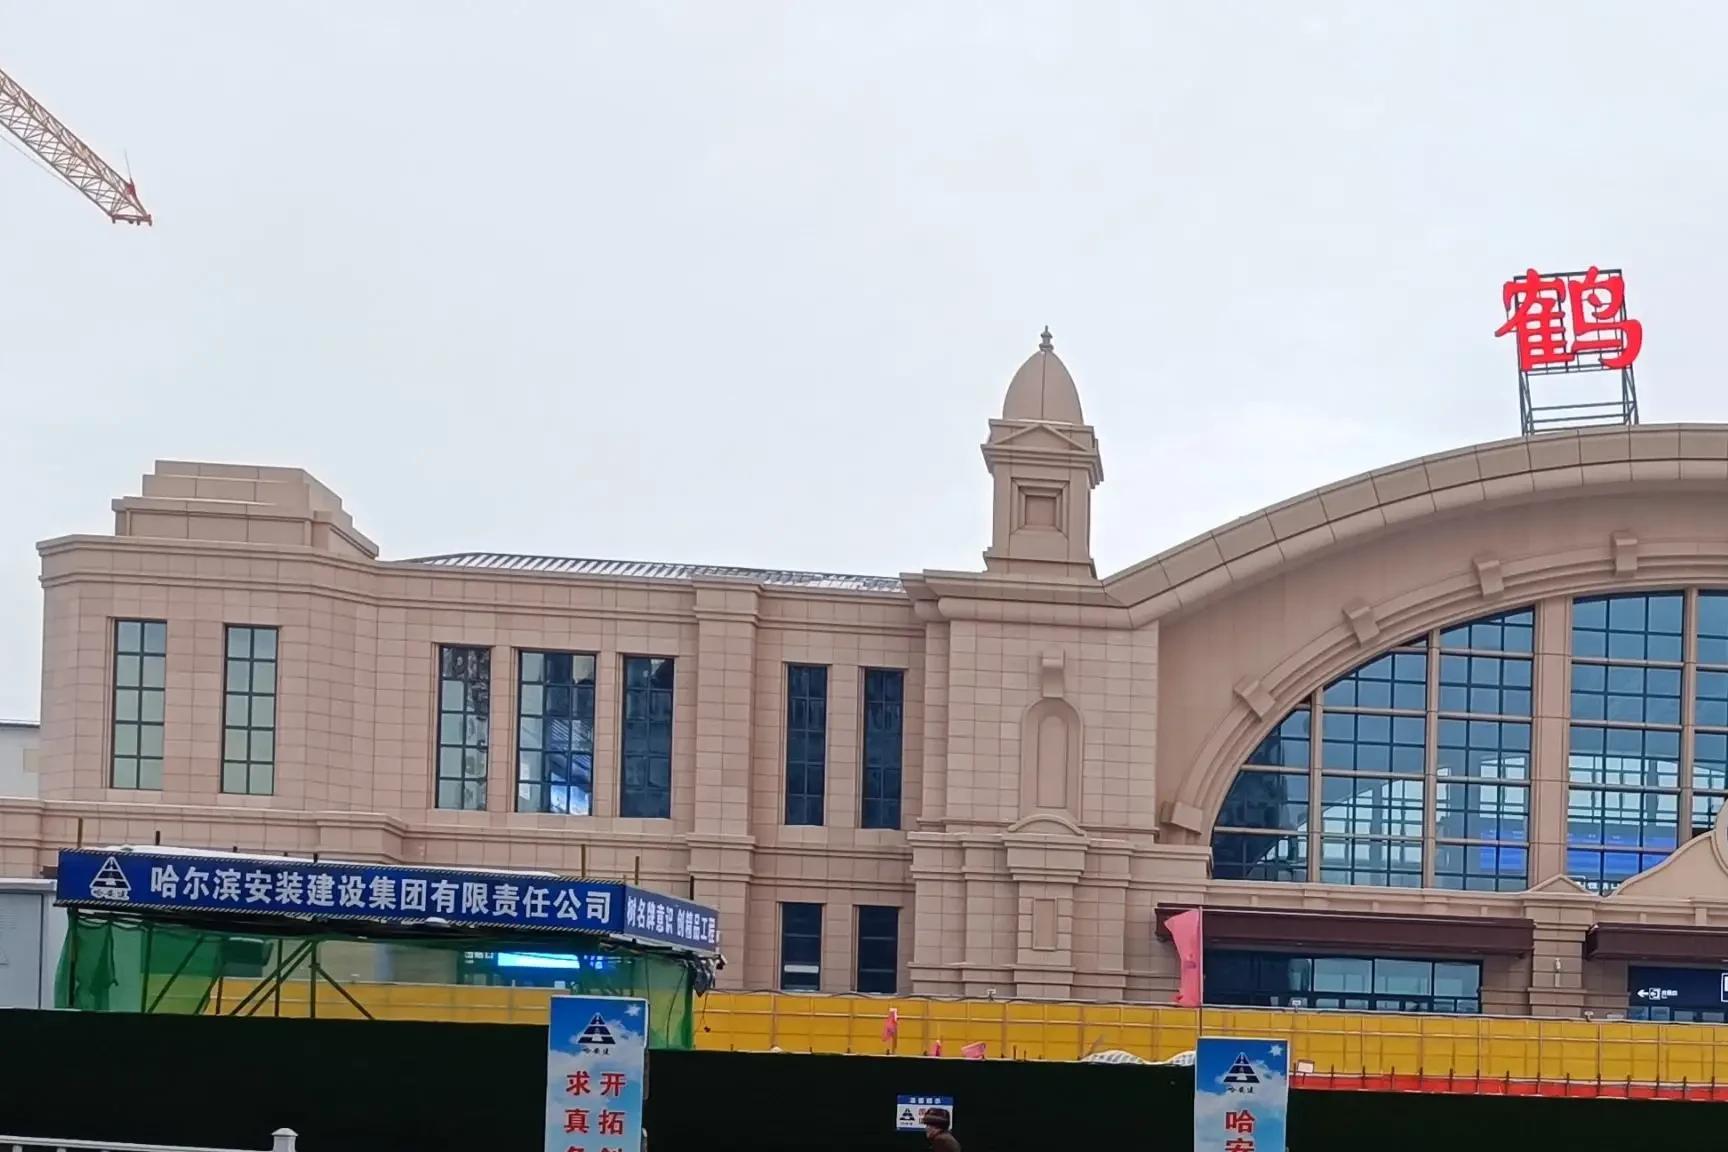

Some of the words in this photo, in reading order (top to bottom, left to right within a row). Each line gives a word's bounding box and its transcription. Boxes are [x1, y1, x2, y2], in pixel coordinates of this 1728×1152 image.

[1494, 266, 1643, 372] 鹤
[150, 863, 612, 924] 哈尔滨安装建设集团有限责任公司
